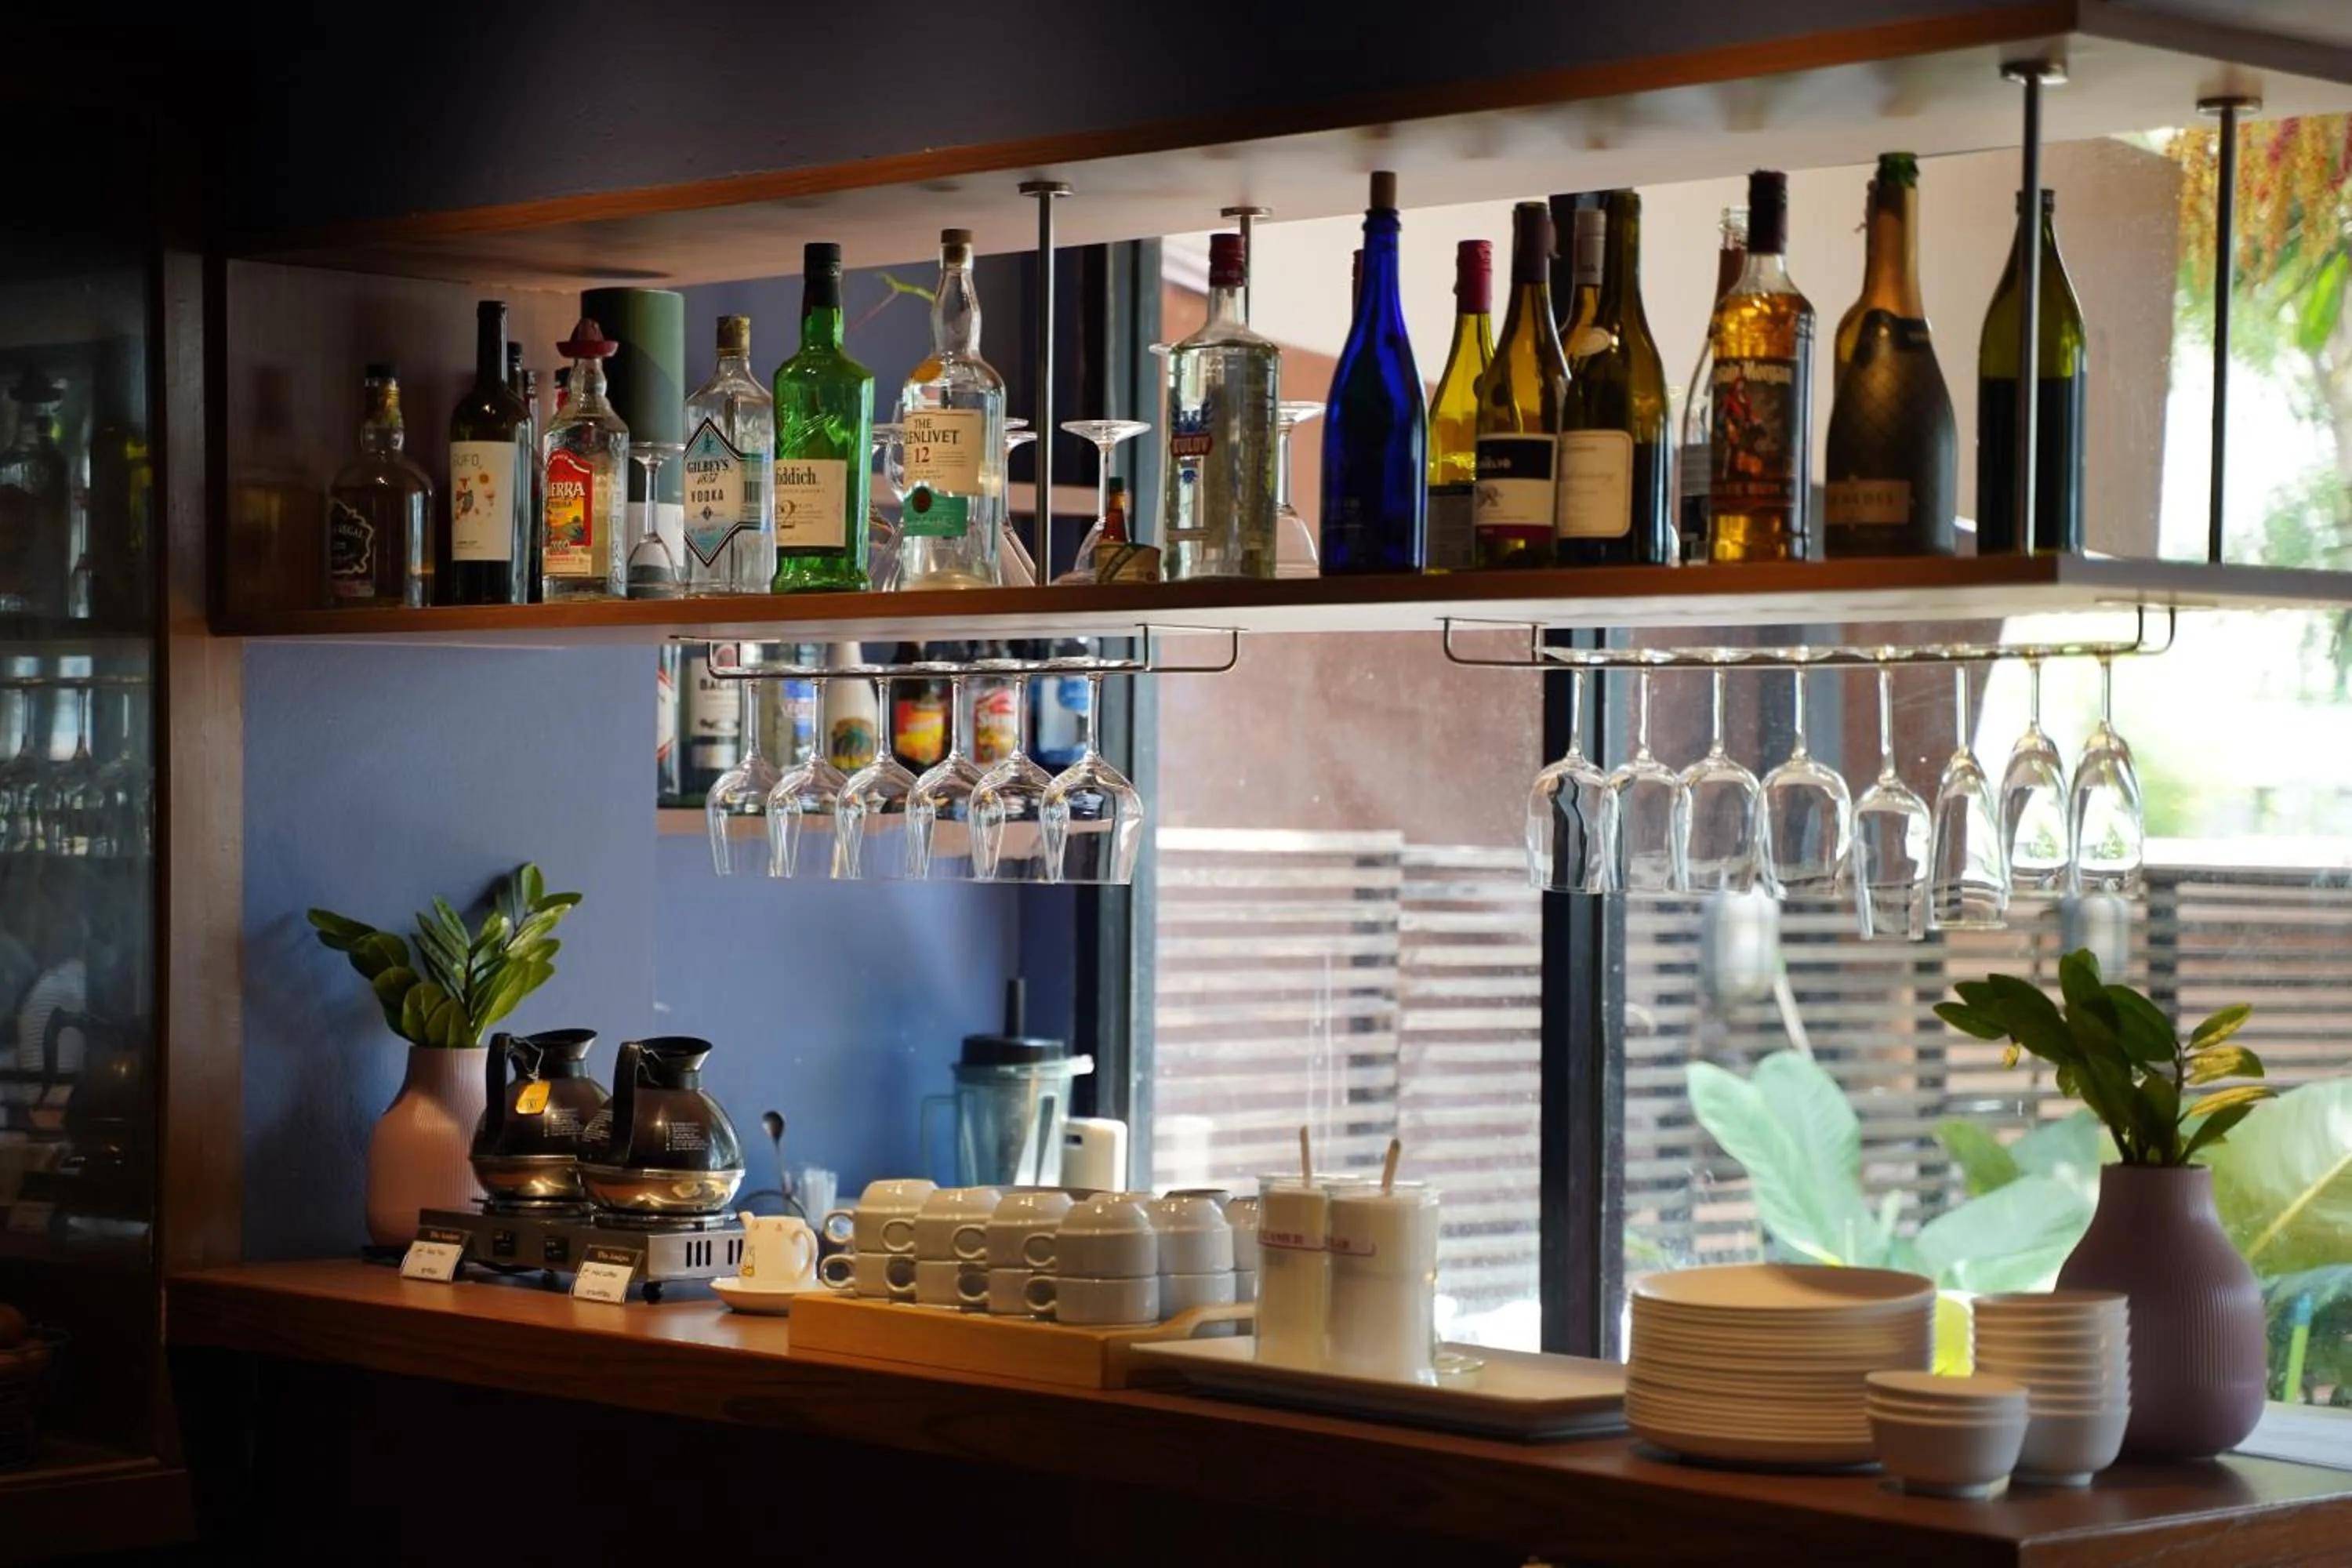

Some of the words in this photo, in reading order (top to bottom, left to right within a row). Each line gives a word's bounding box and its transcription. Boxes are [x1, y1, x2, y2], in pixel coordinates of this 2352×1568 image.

[914, 417, 932, 430] THE
[905, 428, 960, 445] LENLIVET
[914, 446, 931, 463] 12
[691, 489, 724, 503] VODKA
